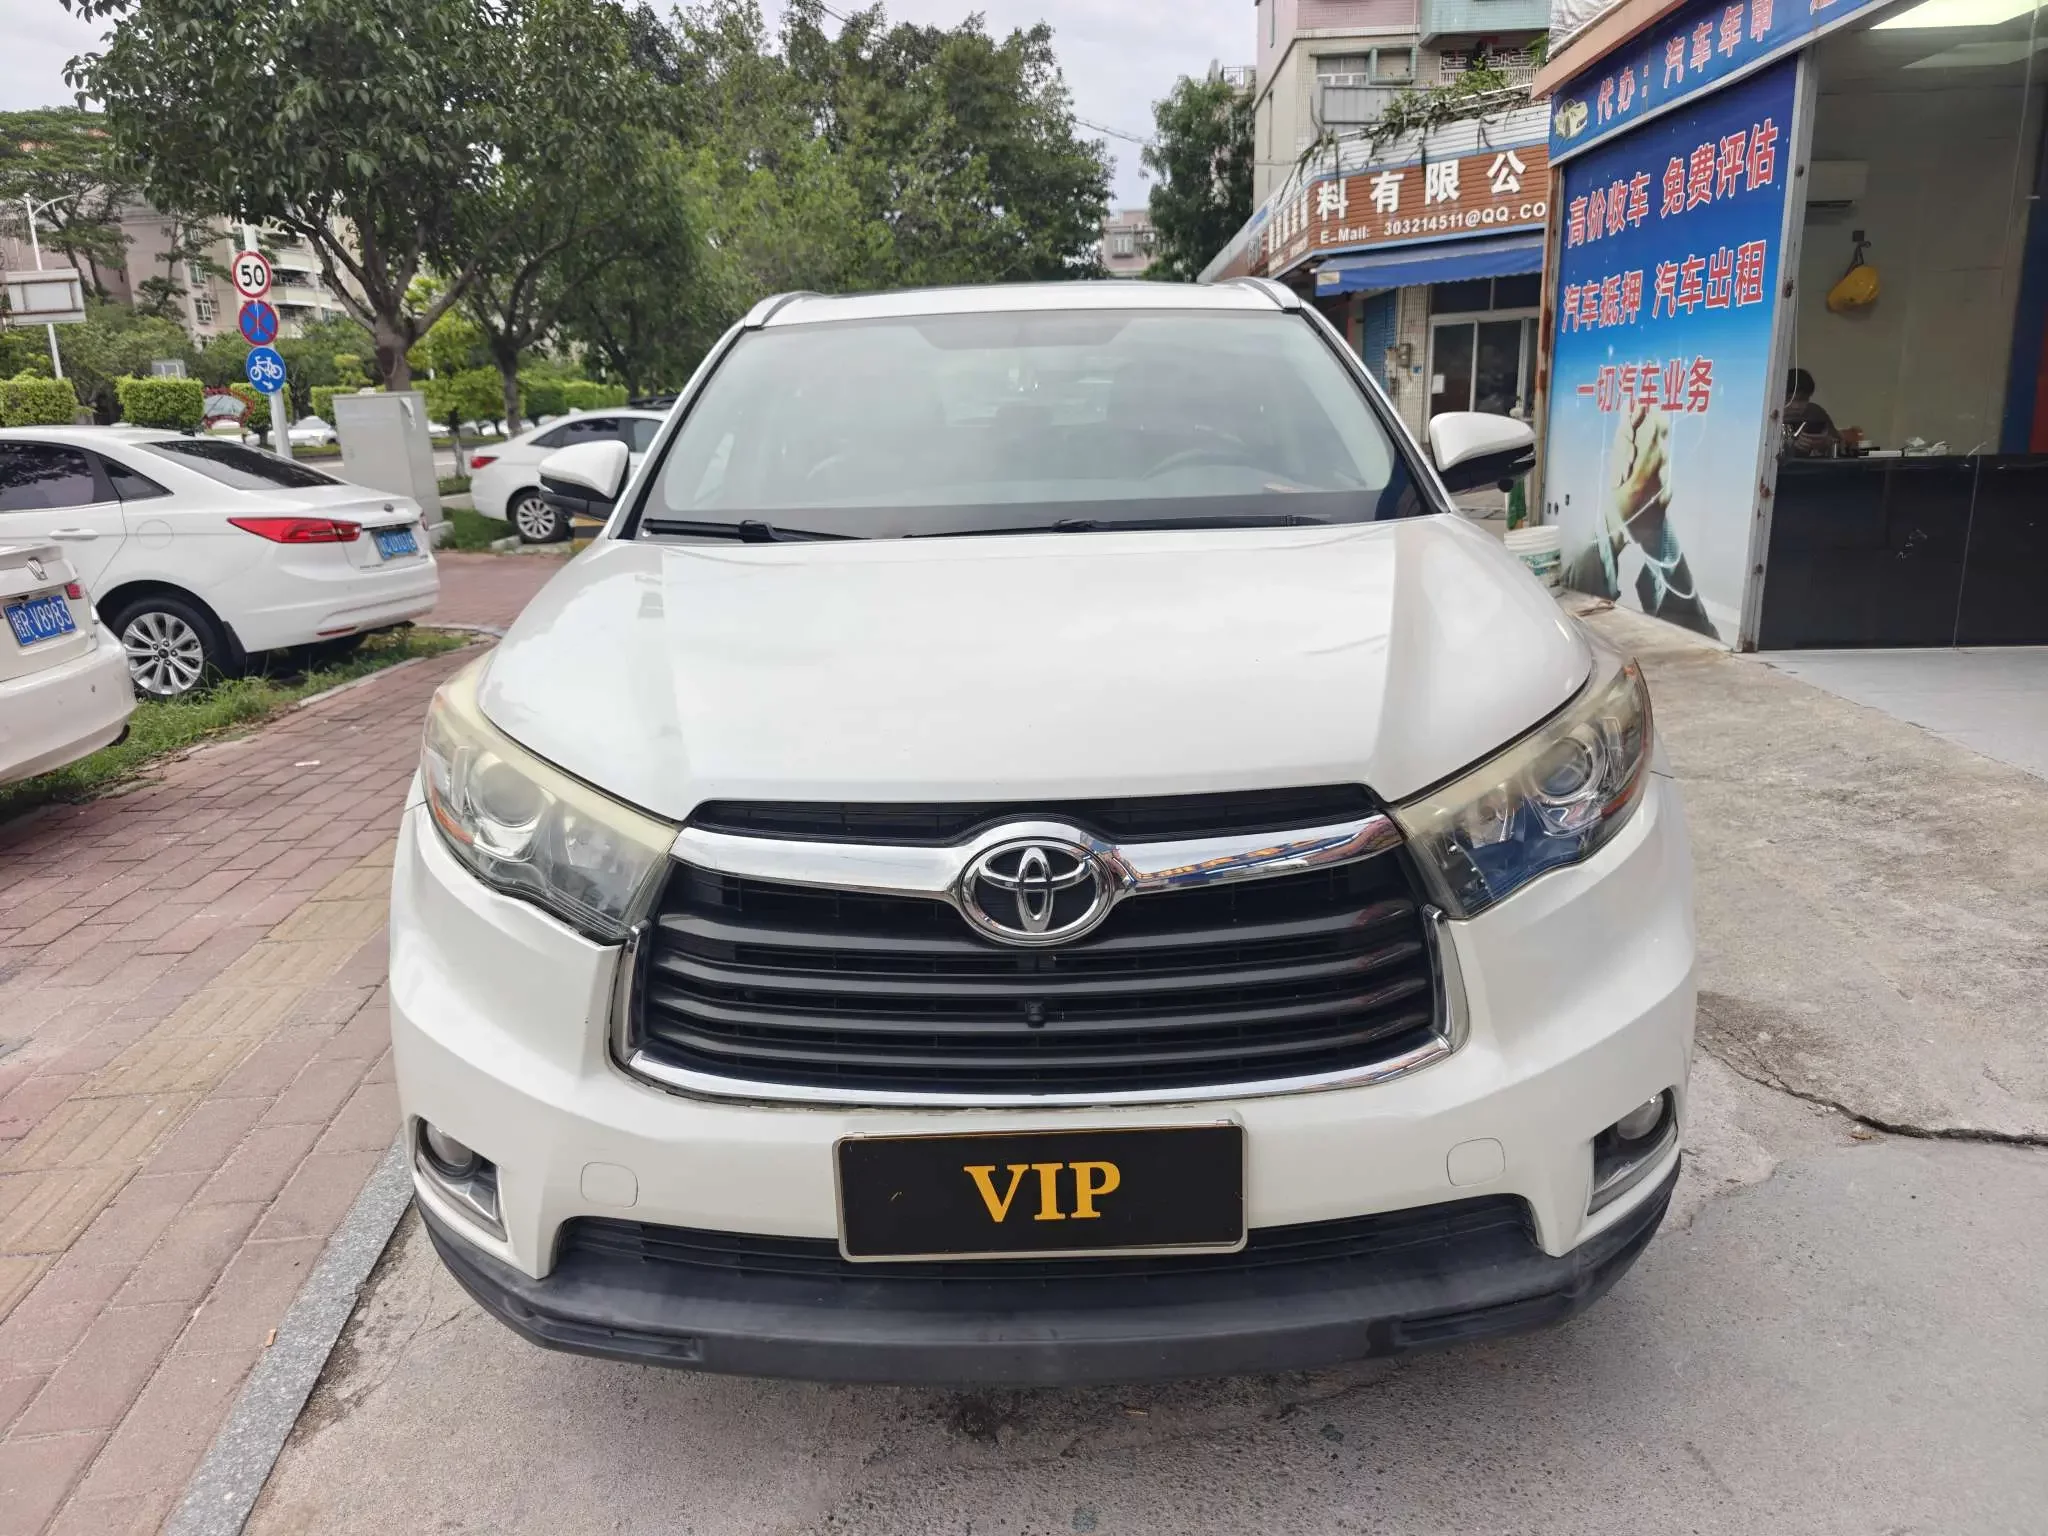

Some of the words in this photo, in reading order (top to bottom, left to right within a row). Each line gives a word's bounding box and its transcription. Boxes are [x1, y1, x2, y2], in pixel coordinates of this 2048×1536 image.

[1567, 172, 1650, 249] 高价收车
[1660, 118, 1778, 219] 免费评估
[241, 264, 265, 287] 50
[1561, 270, 1643, 333] 汽车抵押
[1652, 240, 1766, 318] 汽车出租
[1576, 355, 1713, 413] 一切汽车业务
[963, 1161, 1121, 1222] VIP
